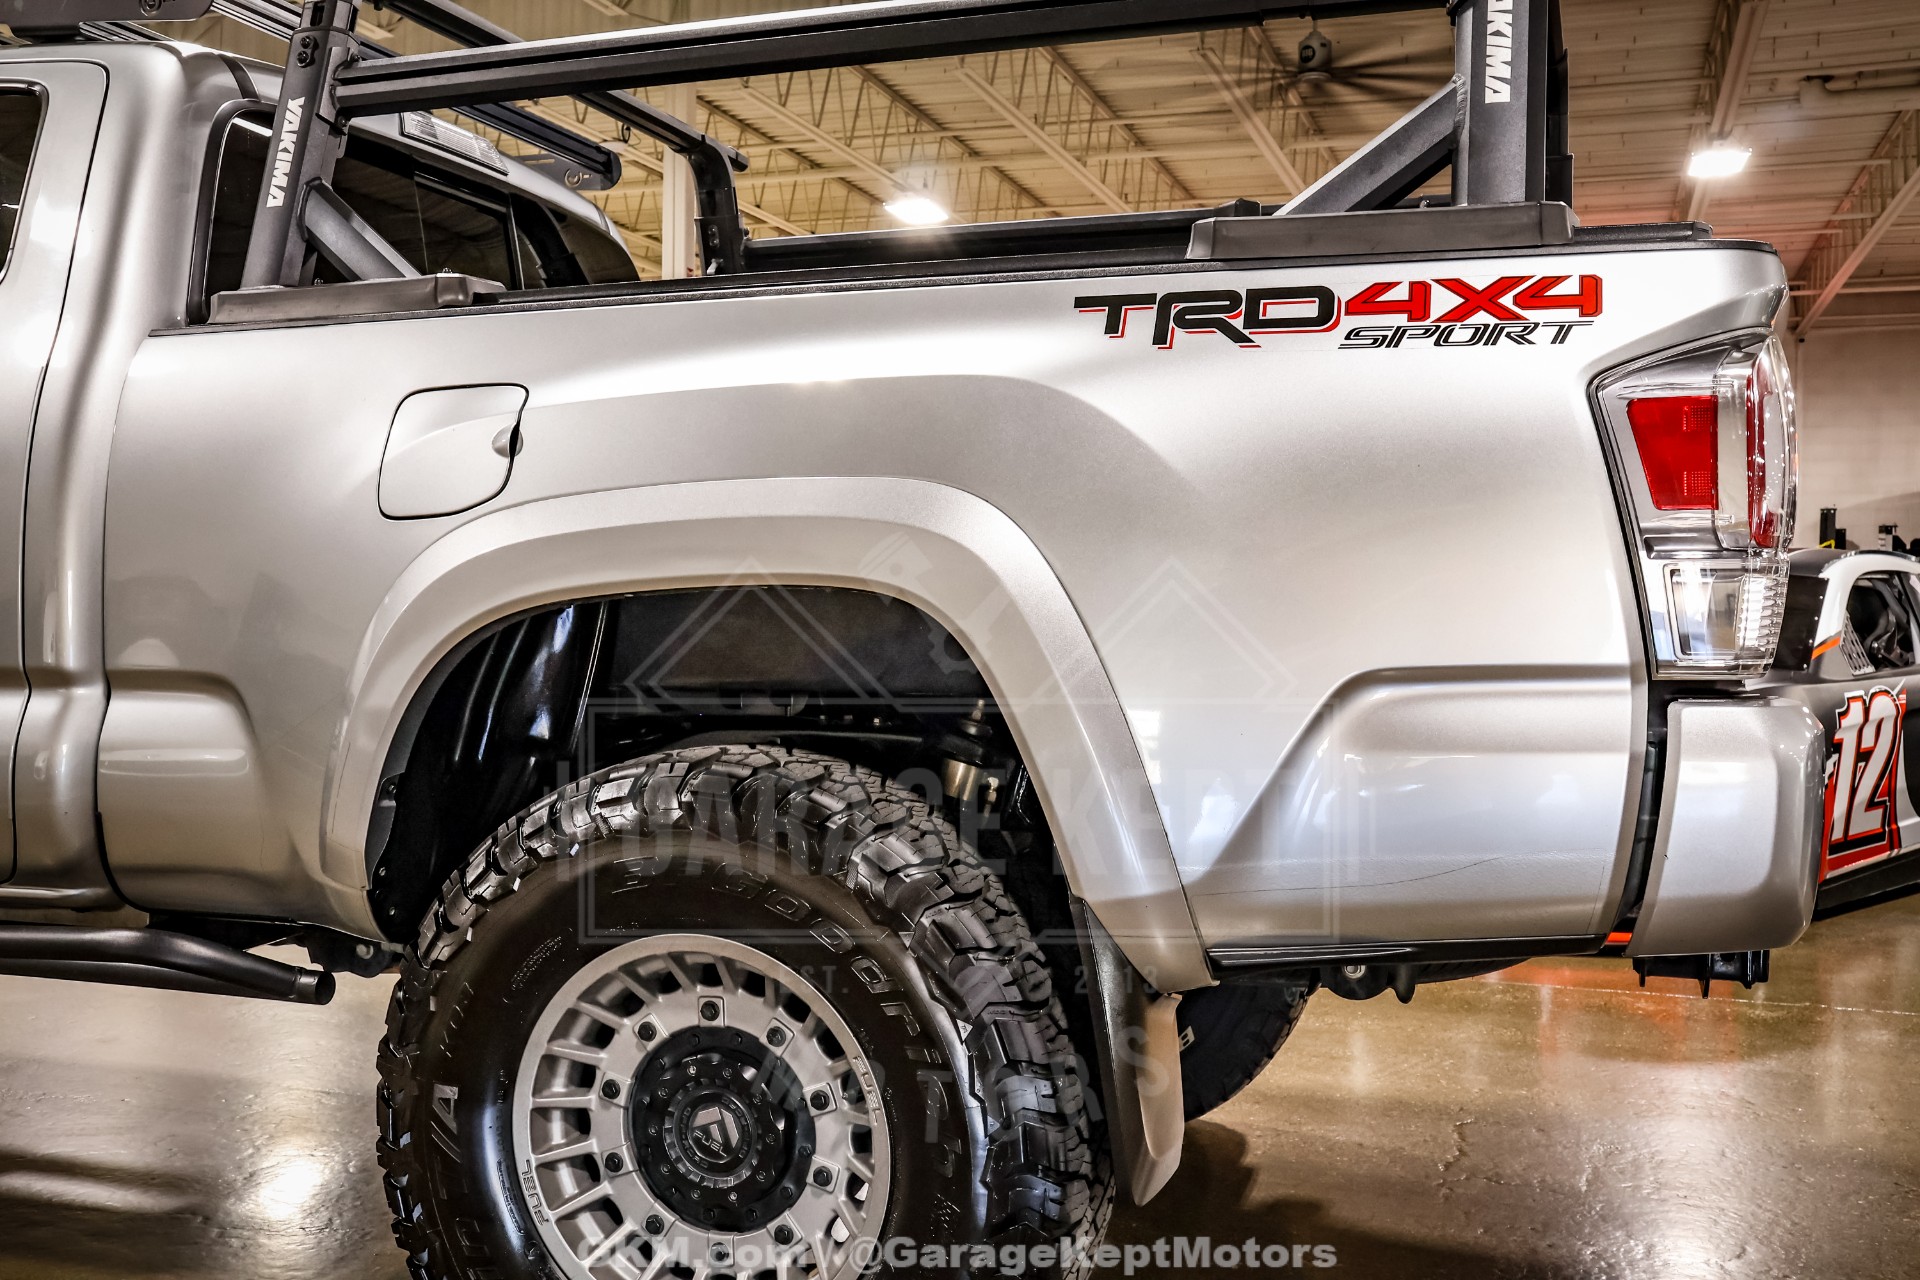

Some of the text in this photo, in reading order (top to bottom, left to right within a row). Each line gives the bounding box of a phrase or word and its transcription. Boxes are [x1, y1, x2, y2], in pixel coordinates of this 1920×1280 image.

[1484, 0, 1513, 104] KIMA
[266, 96, 306, 208] YAKIMA
[1073, 273, 1603, 350] TRD 4X4
[1338, 320, 1594, 350] SPORT
[1827, 685, 1901, 856] 12
[851, 1054, 882, 1126] FUEL
[692, 1128, 728, 1158] FUEL
[521, 1158, 550, 1227] FUEL
